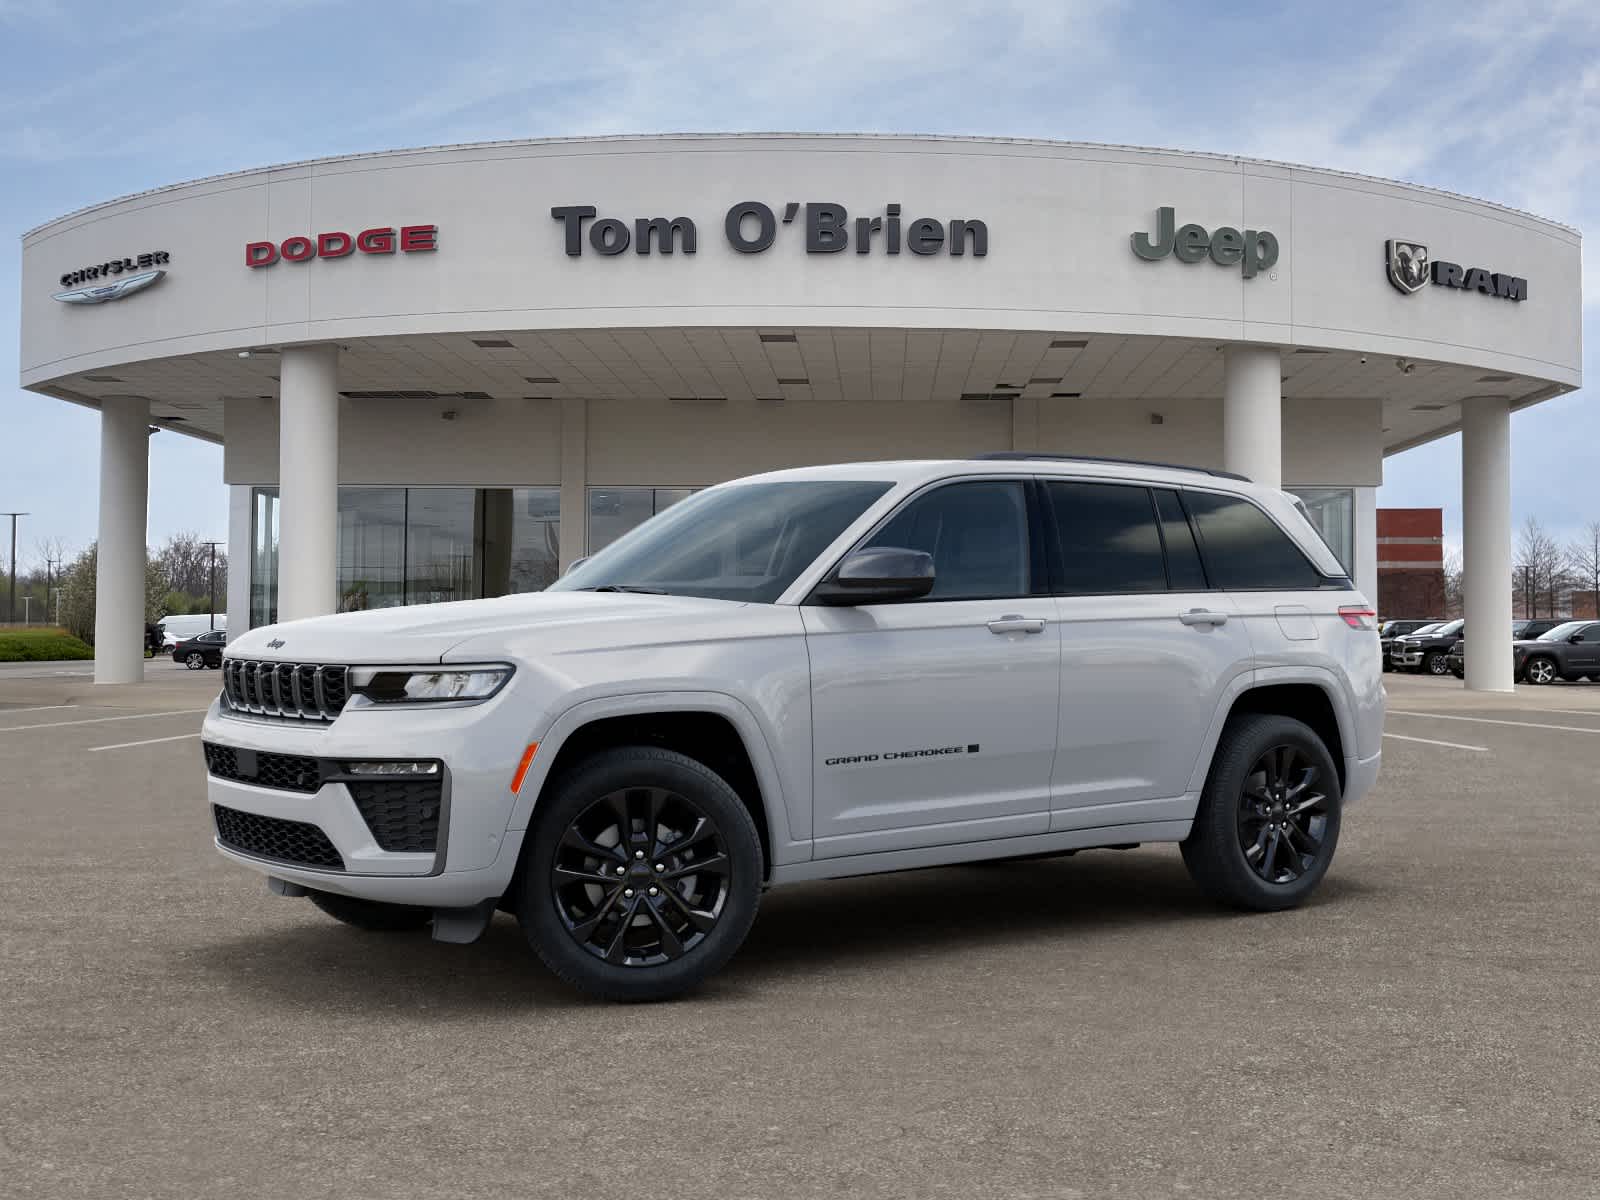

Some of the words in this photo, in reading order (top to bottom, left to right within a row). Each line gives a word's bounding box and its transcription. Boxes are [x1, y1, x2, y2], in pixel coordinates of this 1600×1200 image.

[245, 224, 438, 269] DODGE
[551, 205, 697, 257] Tom
[1130, 206, 1280, 278] Jeep
[59, 249, 170, 287] CHRYSLER
[1430, 260, 1528, 301] RAM
[825, 754, 879, 766] GRAND
[883, 746, 963, 760] CHEROKEE
